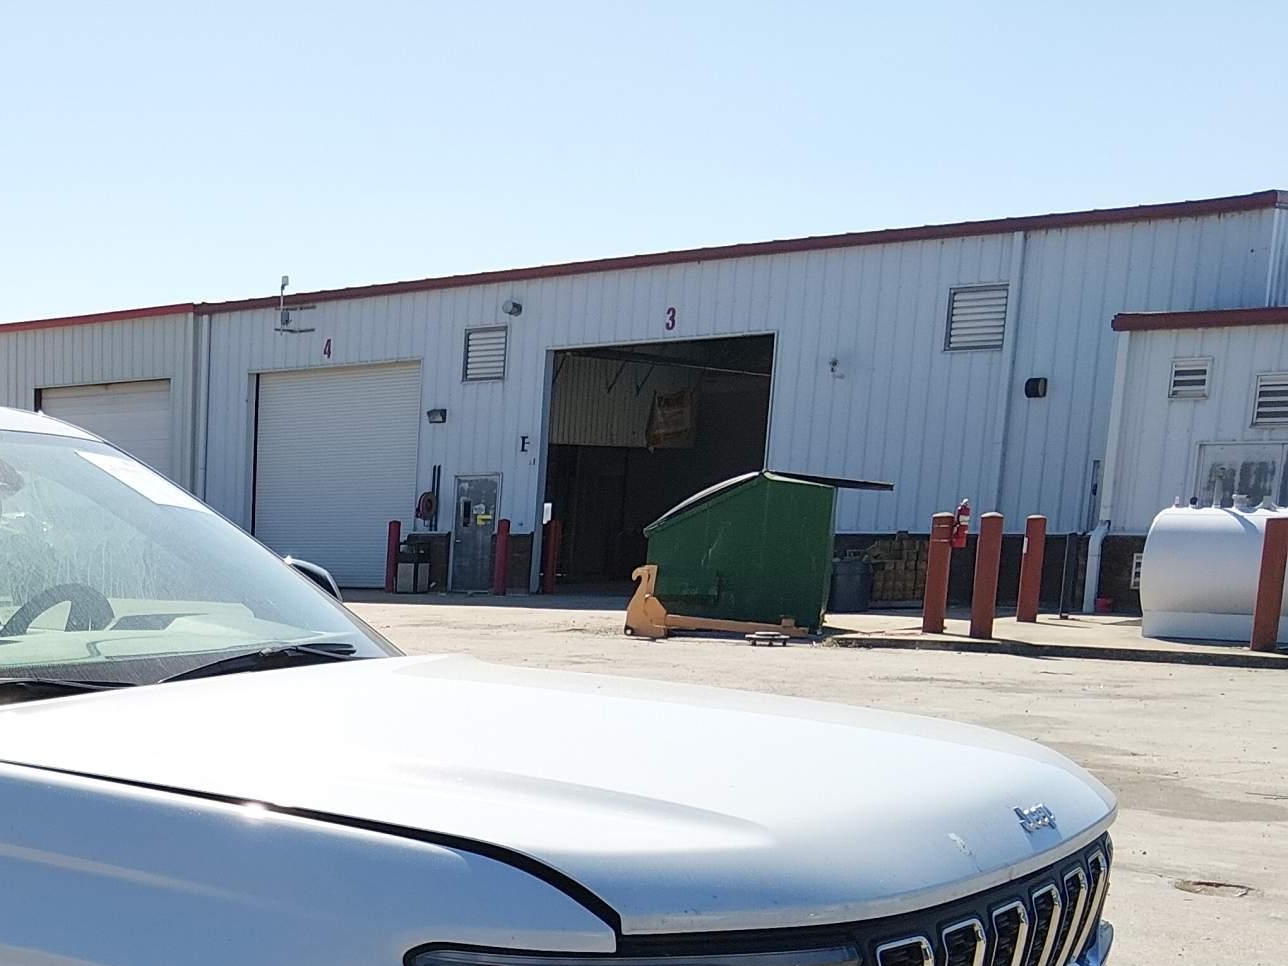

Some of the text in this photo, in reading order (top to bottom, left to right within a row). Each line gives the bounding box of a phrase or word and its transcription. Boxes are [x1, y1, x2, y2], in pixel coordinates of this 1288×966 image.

[665, 306, 676, 331] 3
[323, 338, 332, 359] 4
[520, 435, 530, 452] E
